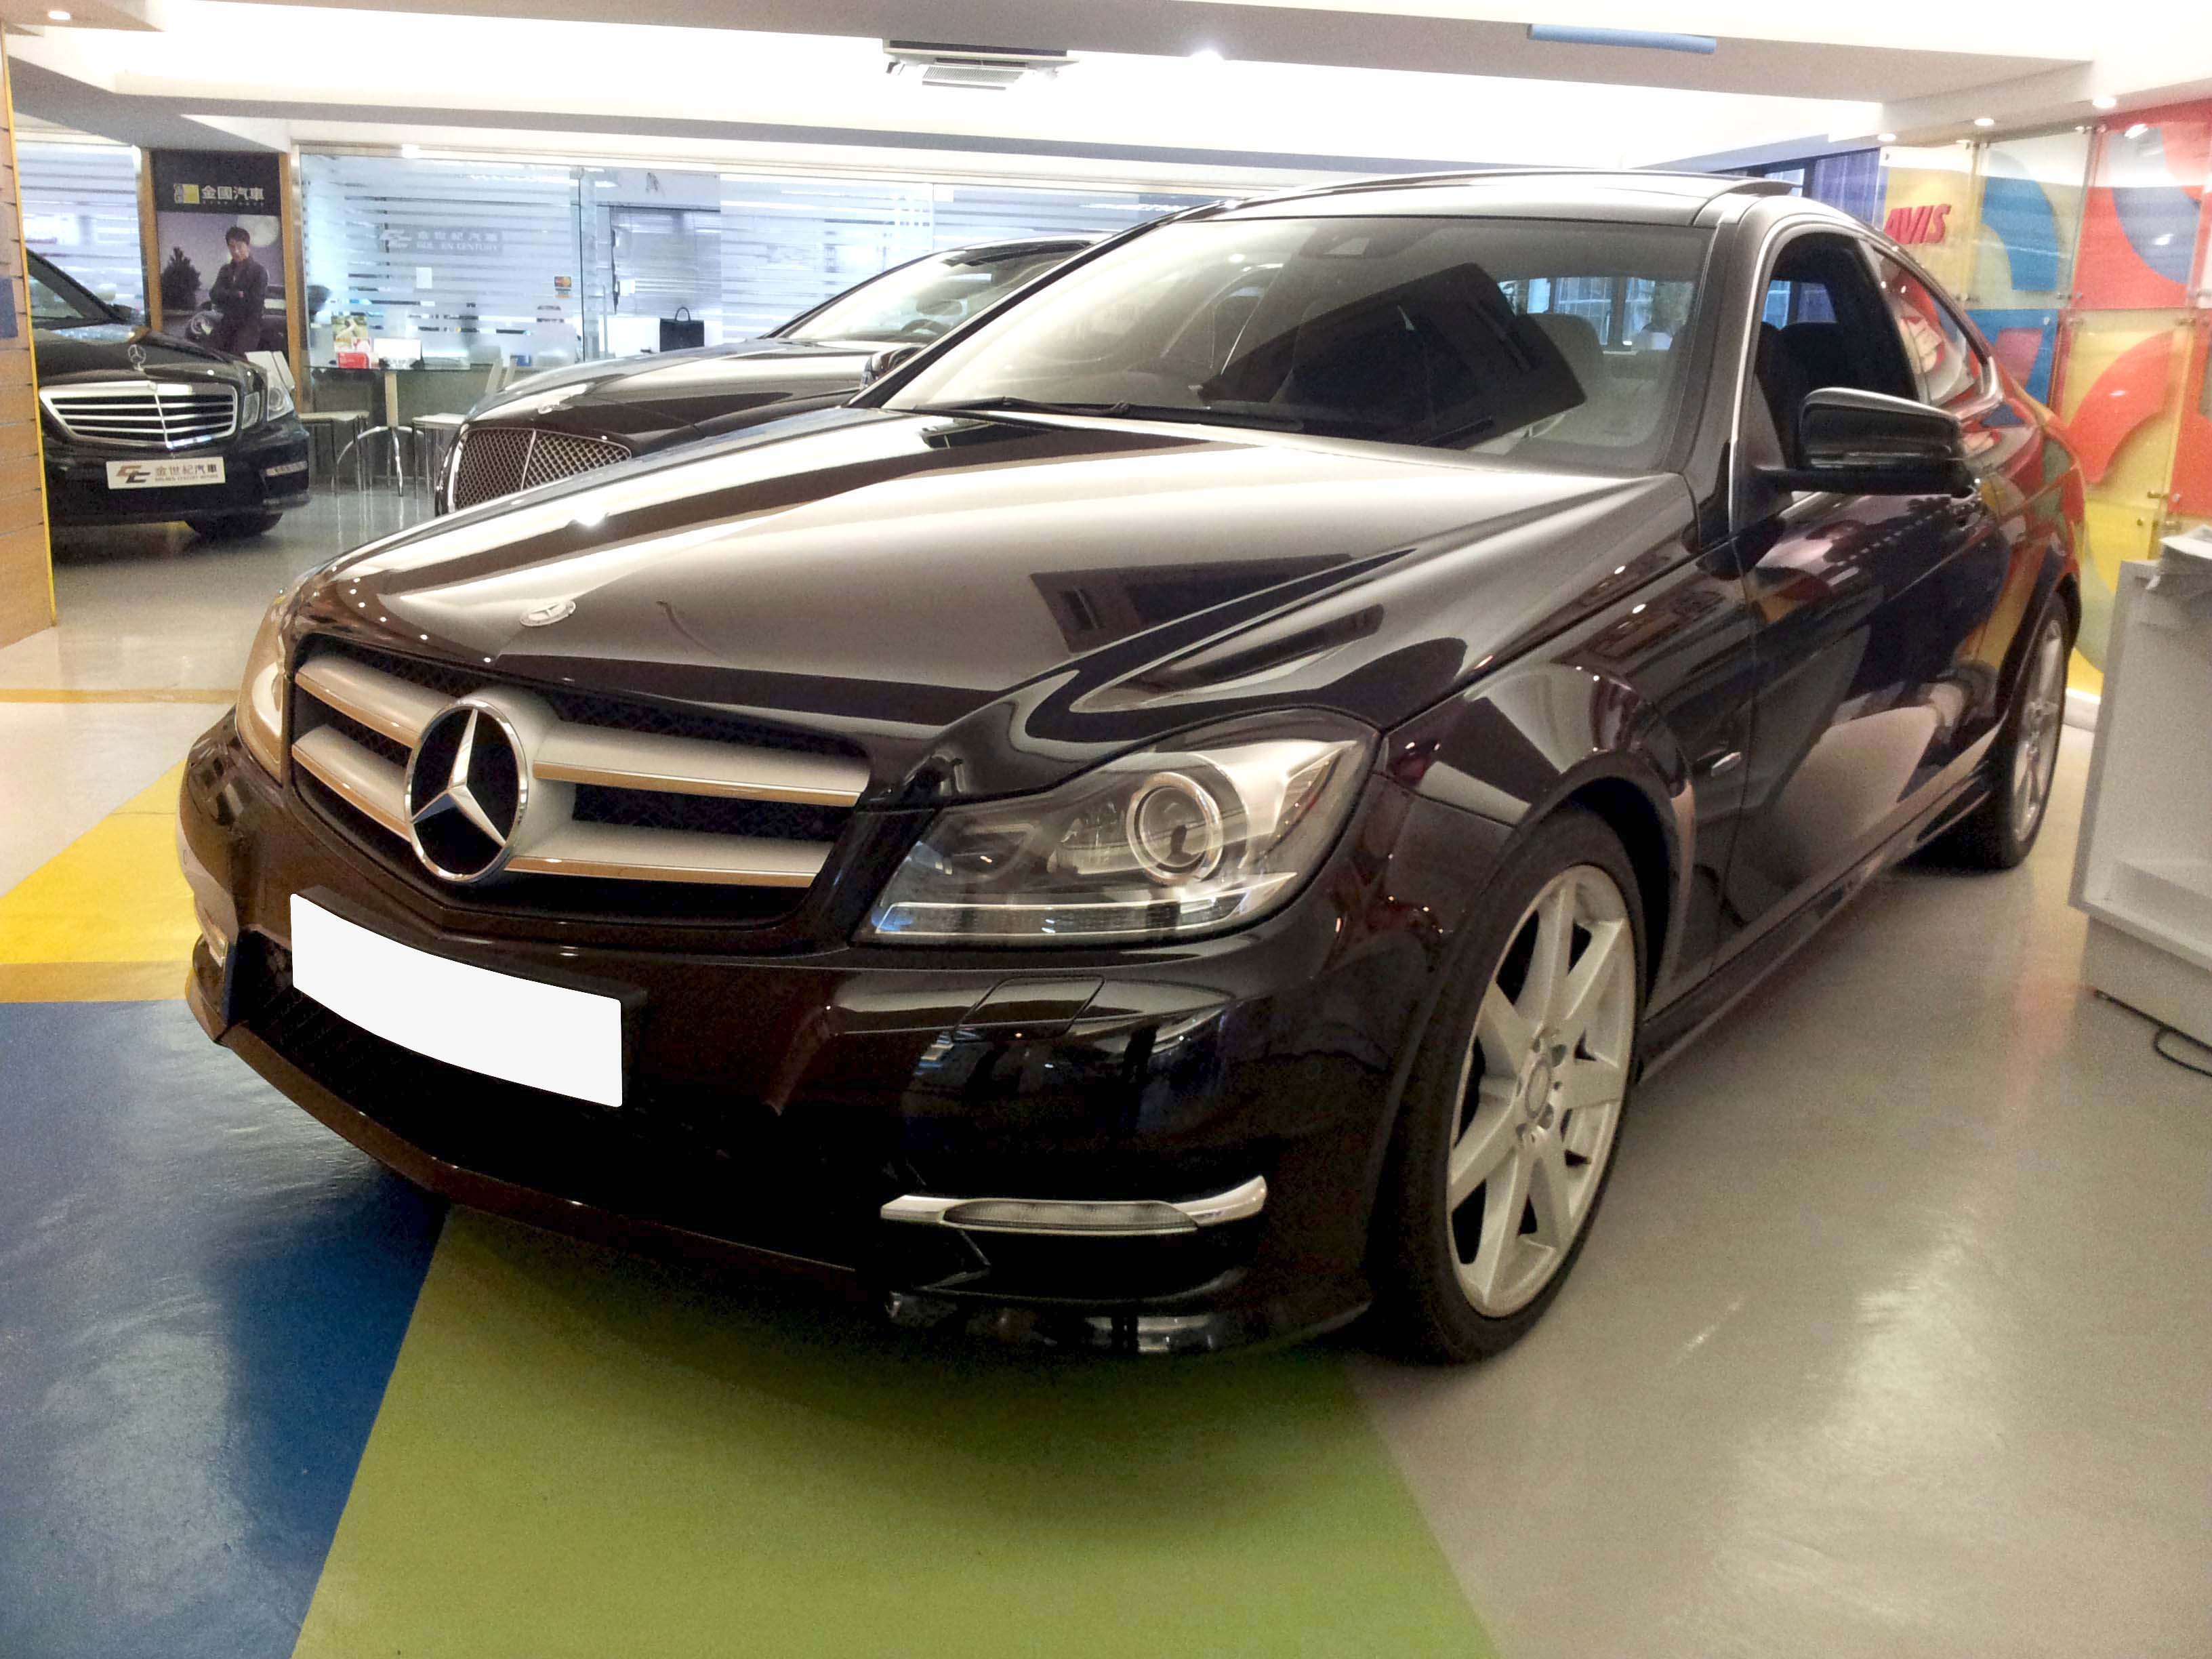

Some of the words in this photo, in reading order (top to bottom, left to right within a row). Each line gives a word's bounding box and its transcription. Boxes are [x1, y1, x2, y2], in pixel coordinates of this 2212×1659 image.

[1884, 204, 1952, 244] AVIS
[155, 464, 217, 476] 金世紀汽車
